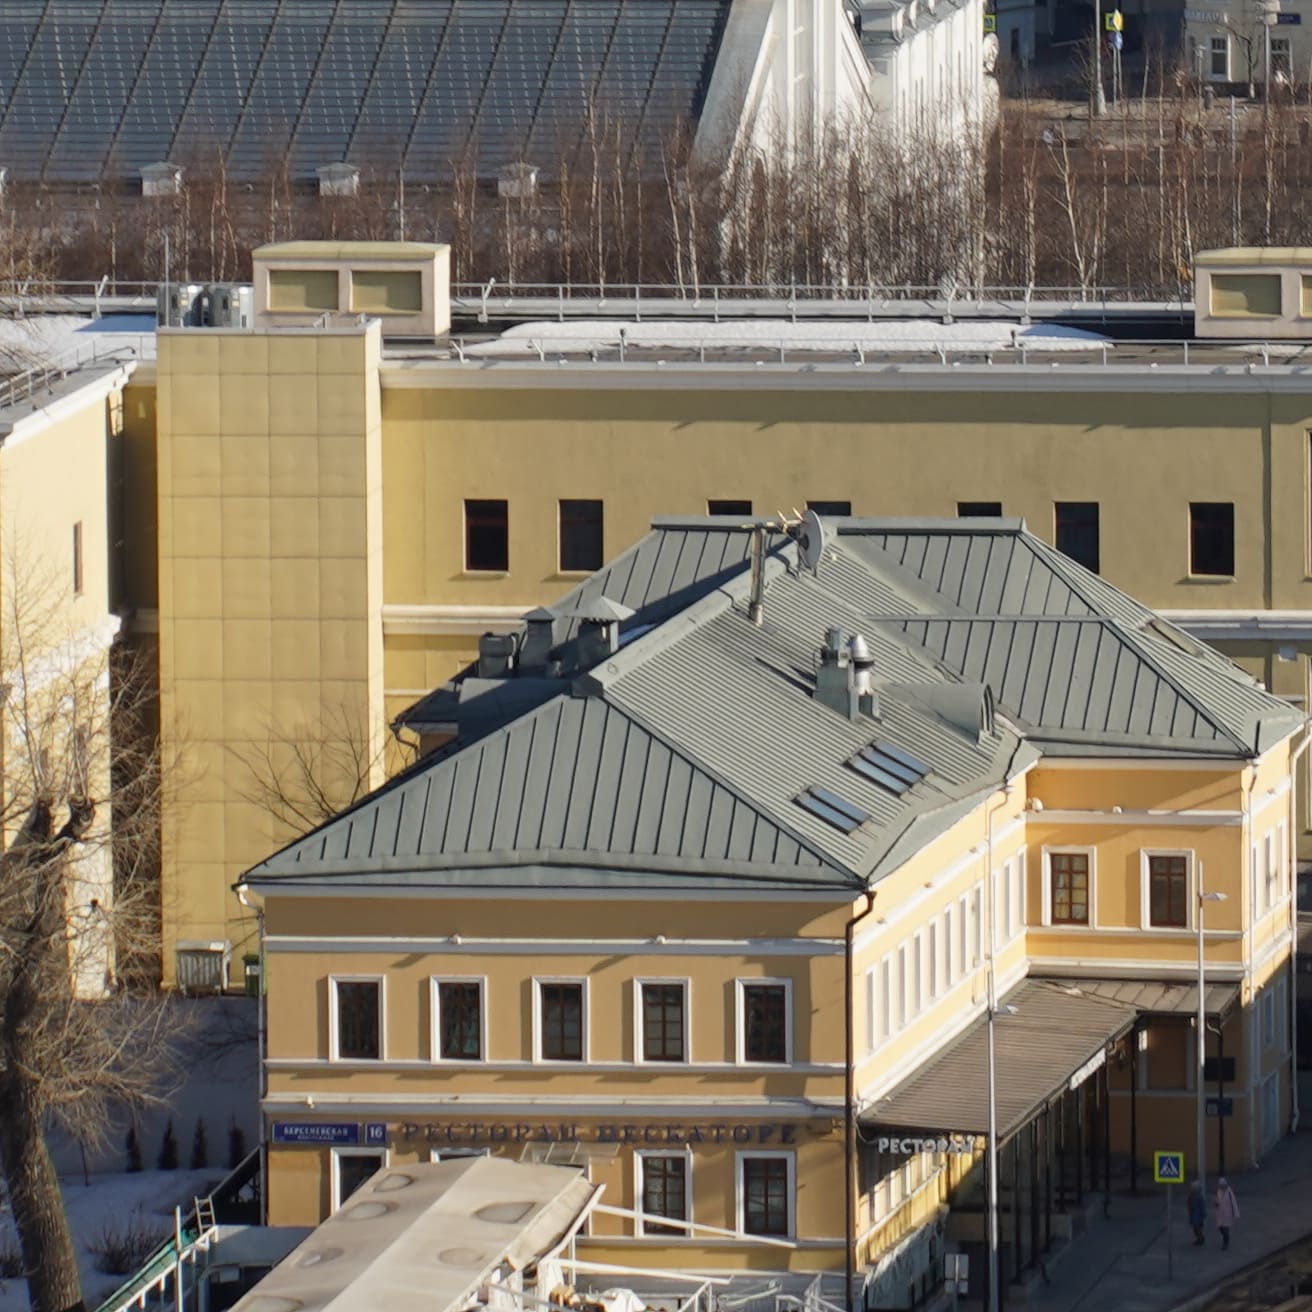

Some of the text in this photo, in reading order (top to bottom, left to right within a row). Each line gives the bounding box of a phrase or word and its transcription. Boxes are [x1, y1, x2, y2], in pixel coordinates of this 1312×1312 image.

[369, 1126, 383, 1138] 16
[403, 1122, 796, 1144] РЕСТОРАН ПЕСКАТОРЕ
[878, 1134, 974, 1154] РЕСТОРАН
